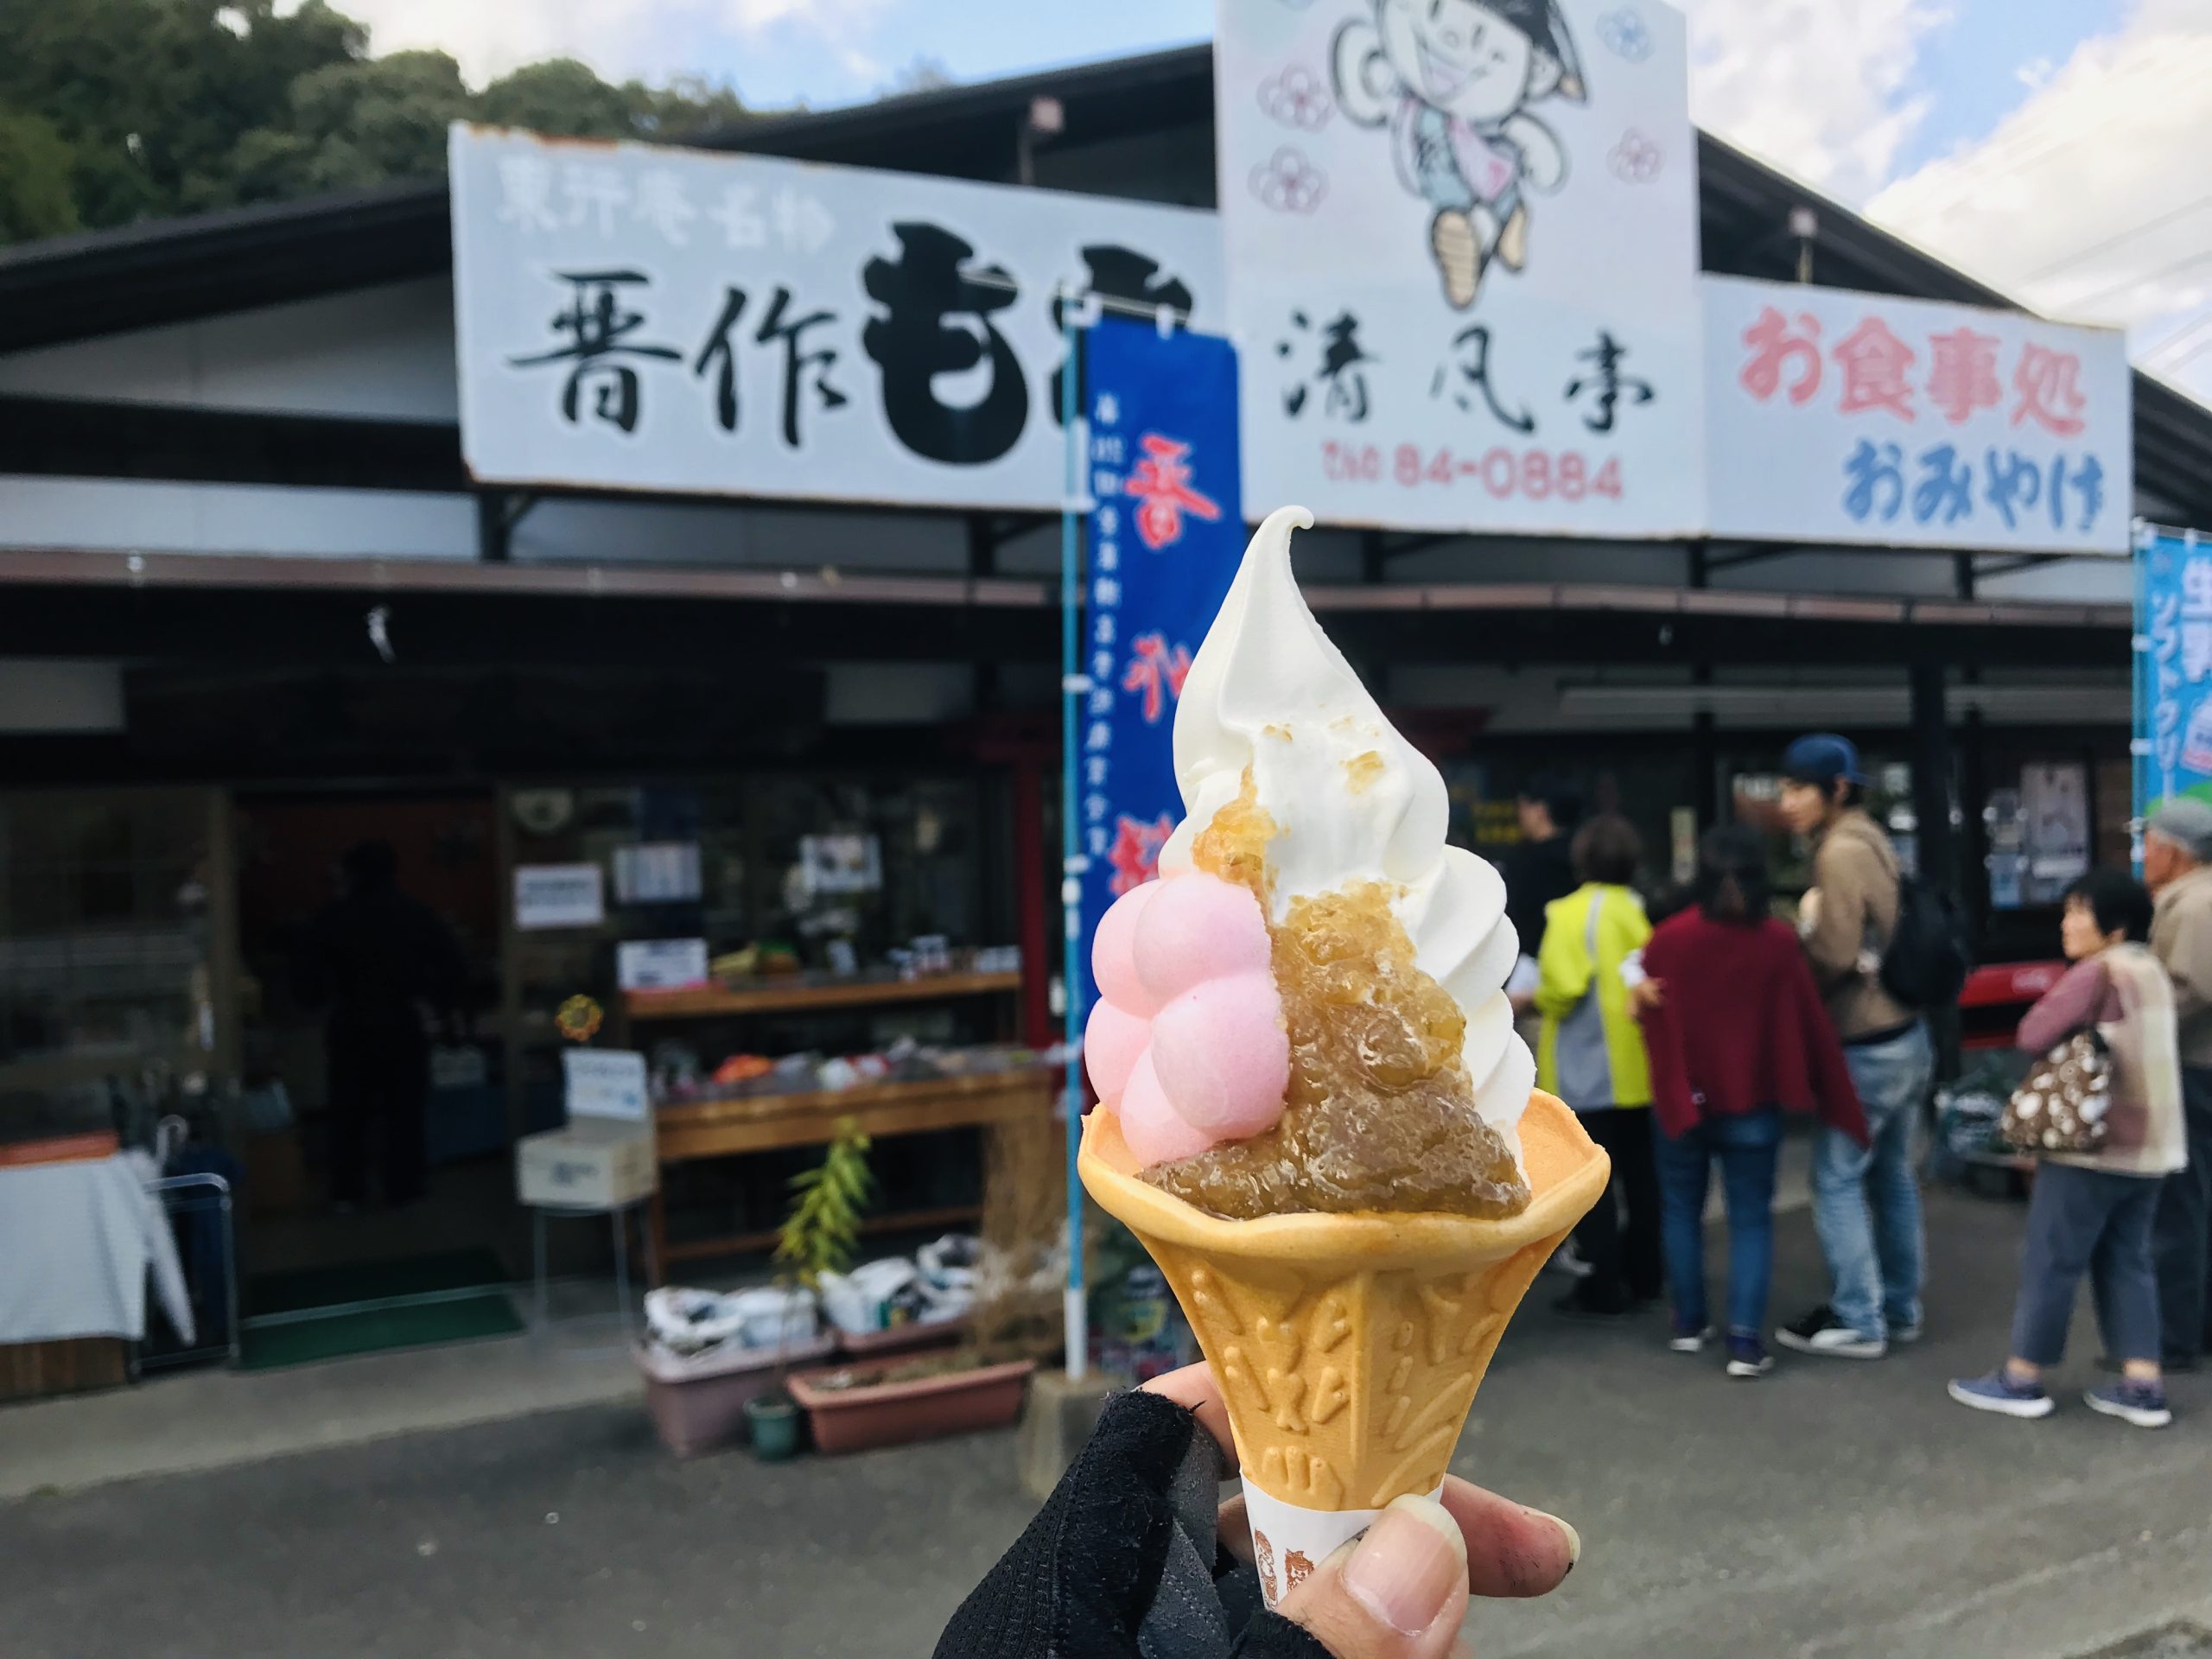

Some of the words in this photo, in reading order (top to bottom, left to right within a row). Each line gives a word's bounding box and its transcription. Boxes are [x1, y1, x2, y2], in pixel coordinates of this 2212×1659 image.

[1740, 307, 2086, 436] お食事処
[1394, 443, 1624, 500] 84-0884
